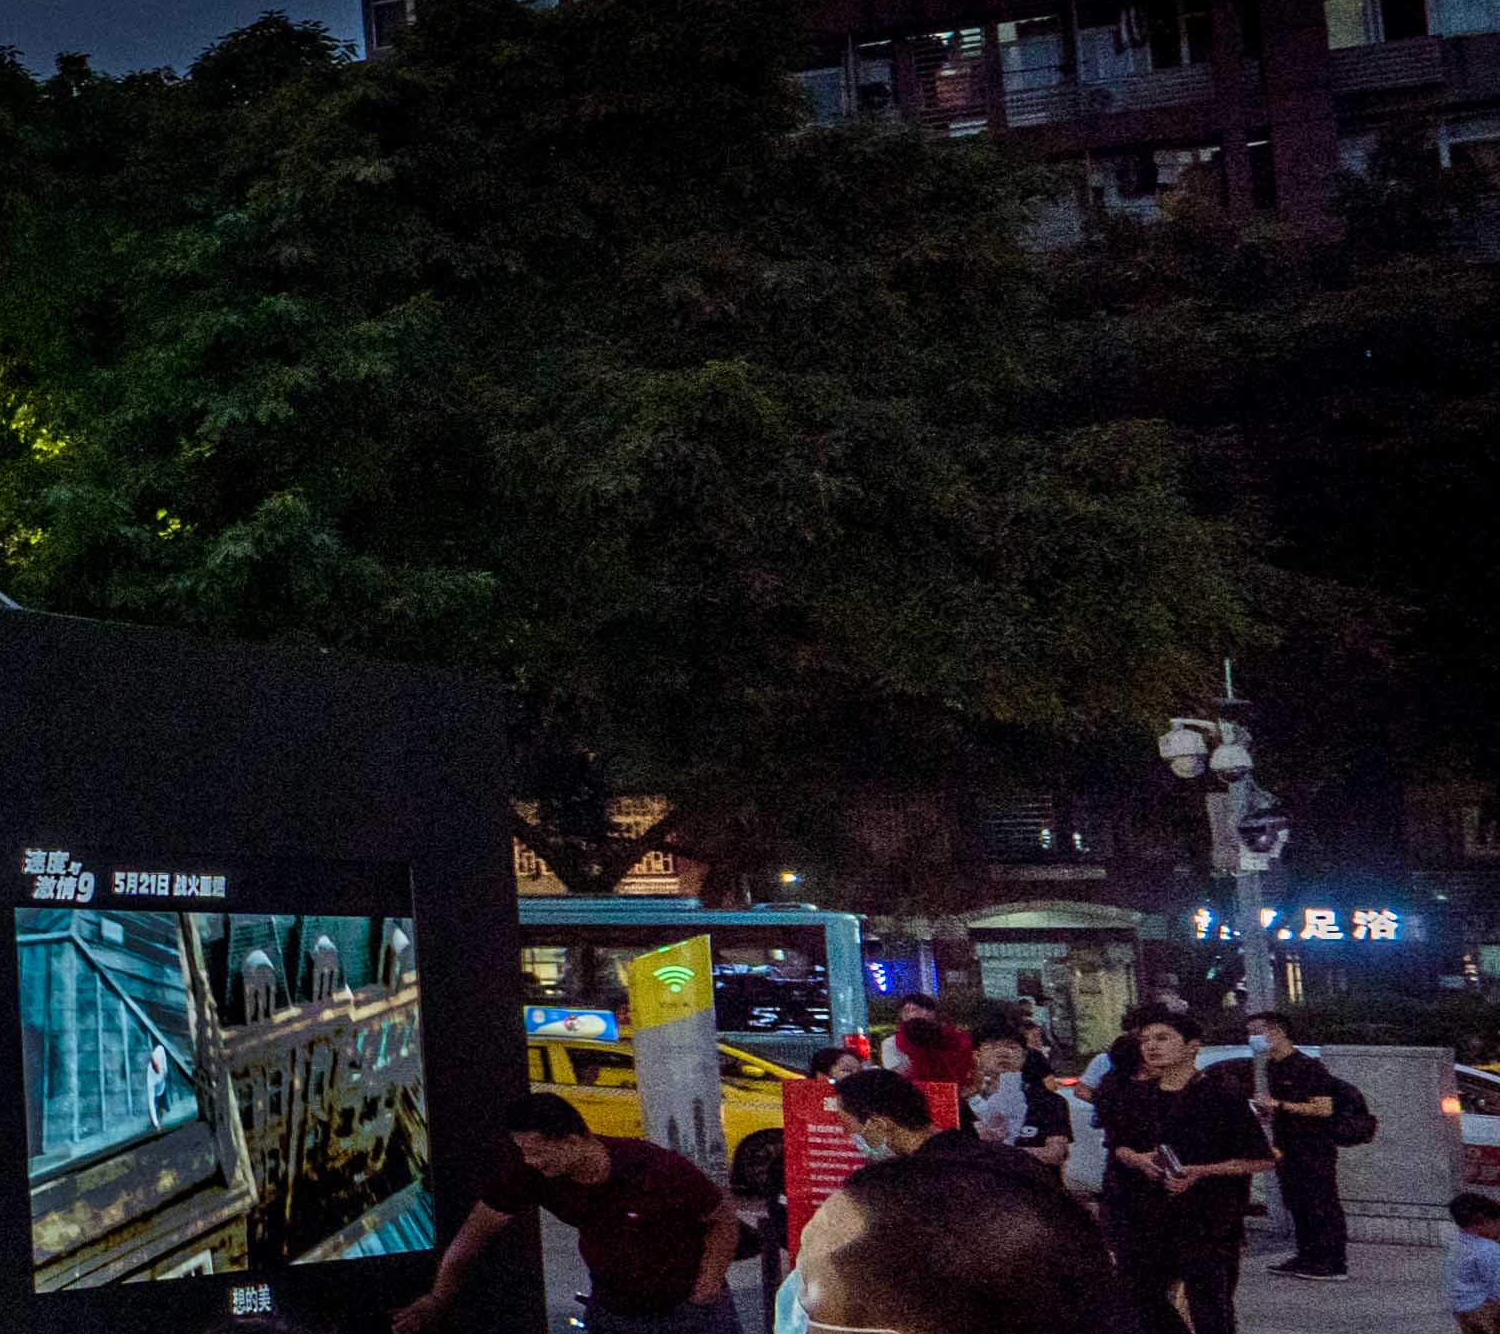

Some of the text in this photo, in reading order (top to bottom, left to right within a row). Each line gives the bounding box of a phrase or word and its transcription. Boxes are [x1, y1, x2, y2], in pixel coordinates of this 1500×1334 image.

[22, 849, 82, 876] 速度与
[32, 872, 95, 903] 激情9
[113, 872, 170, 896] 5月21日
